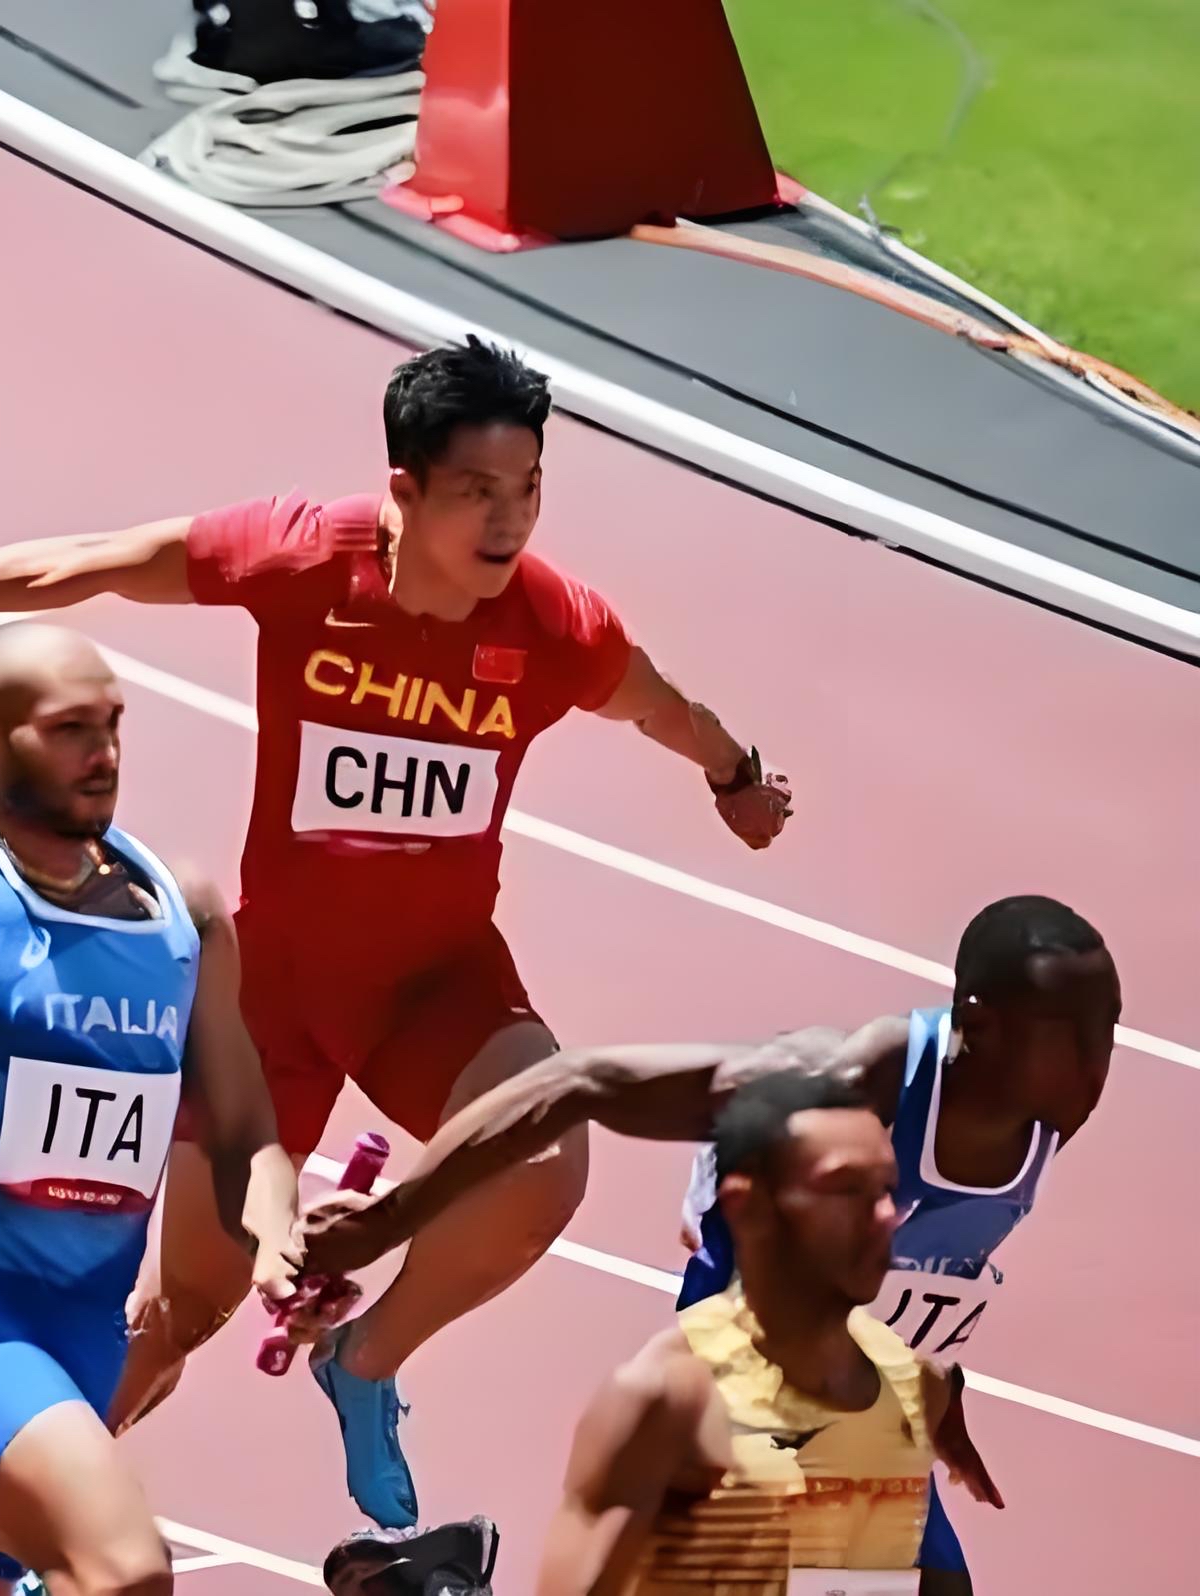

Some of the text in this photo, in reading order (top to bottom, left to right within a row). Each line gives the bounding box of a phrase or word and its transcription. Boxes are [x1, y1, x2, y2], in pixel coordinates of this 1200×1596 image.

[304, 650, 517, 739] CHINA
[325, 746, 471, 818] CHN
[42, 1083, 144, 1163] ITA
